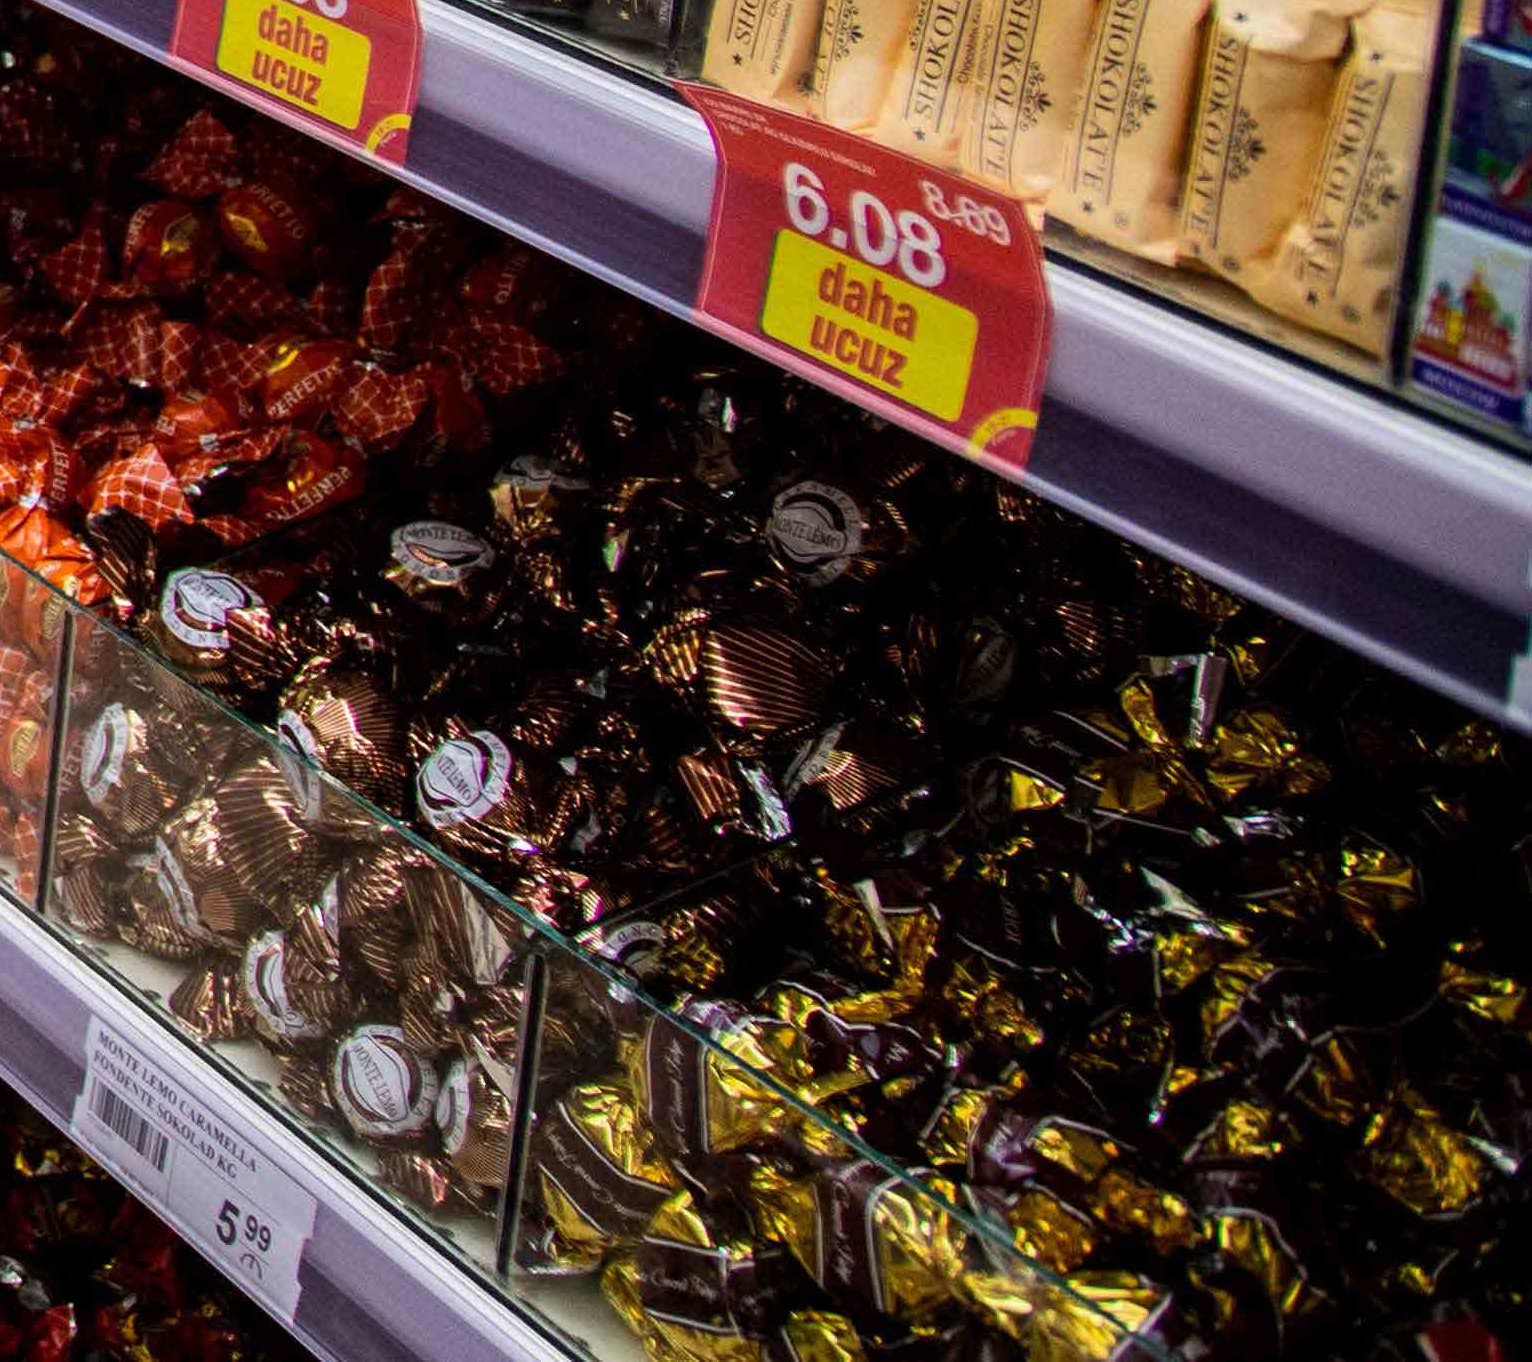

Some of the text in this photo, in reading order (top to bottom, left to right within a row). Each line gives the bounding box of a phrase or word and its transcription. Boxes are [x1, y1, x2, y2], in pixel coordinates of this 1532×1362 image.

[257, 4, 329, 68] daha
[251, 49, 323, 107] ucuz
[782, 162, 947, 288] 6.08
[920, 179, 1011, 247] 8.69
[817, 261, 918, 343] daha
[809, 314, 909, 389] ucuz
[93, 1050, 239, 1180] FONDENTE SOKOLAD KG
[98, 1030, 259, 1174] MONTE LEMO CARAMELLA
[214, 1198, 273, 1253] 5 99
